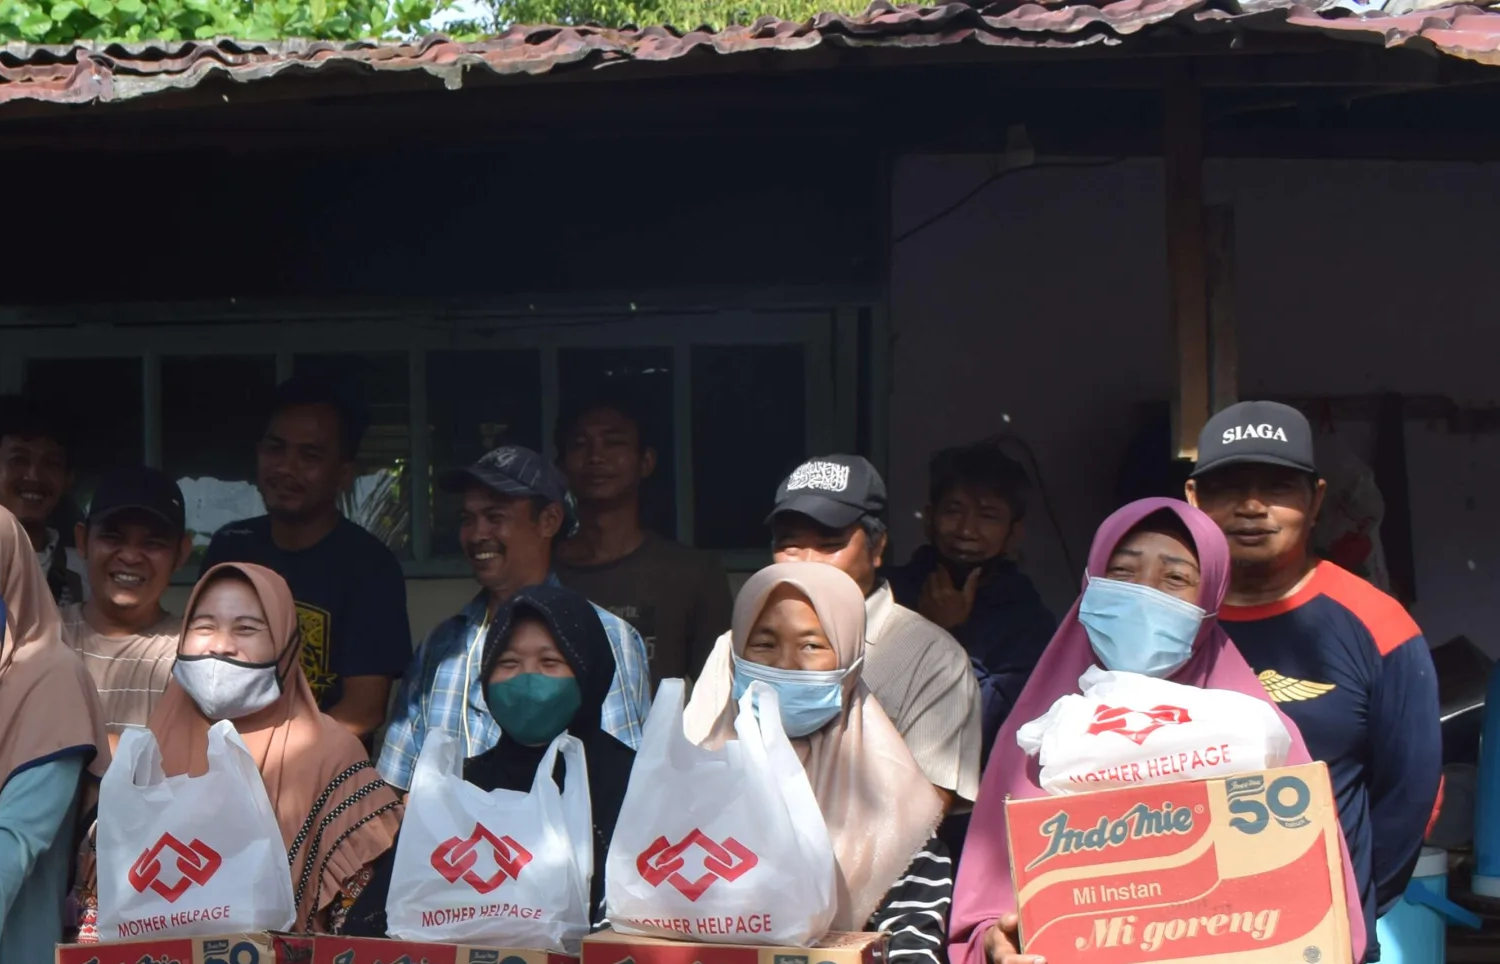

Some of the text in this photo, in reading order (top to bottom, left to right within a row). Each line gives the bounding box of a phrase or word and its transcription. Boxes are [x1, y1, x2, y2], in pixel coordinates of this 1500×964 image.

[1222, 424, 1288, 444] SIAGA
[1148, 744, 1231, 777] HELPAGE
[1226, 775, 1311, 835] 50
[1072, 880, 1161, 905] Mi Instan
[118, 905, 231, 937] MOTHER HELPAGE
[421, 903, 542, 927] MOTHER HELPAGE
[696, 914, 772, 934] HELPAGE
[1075, 909, 1280, 951] Mi goreng
